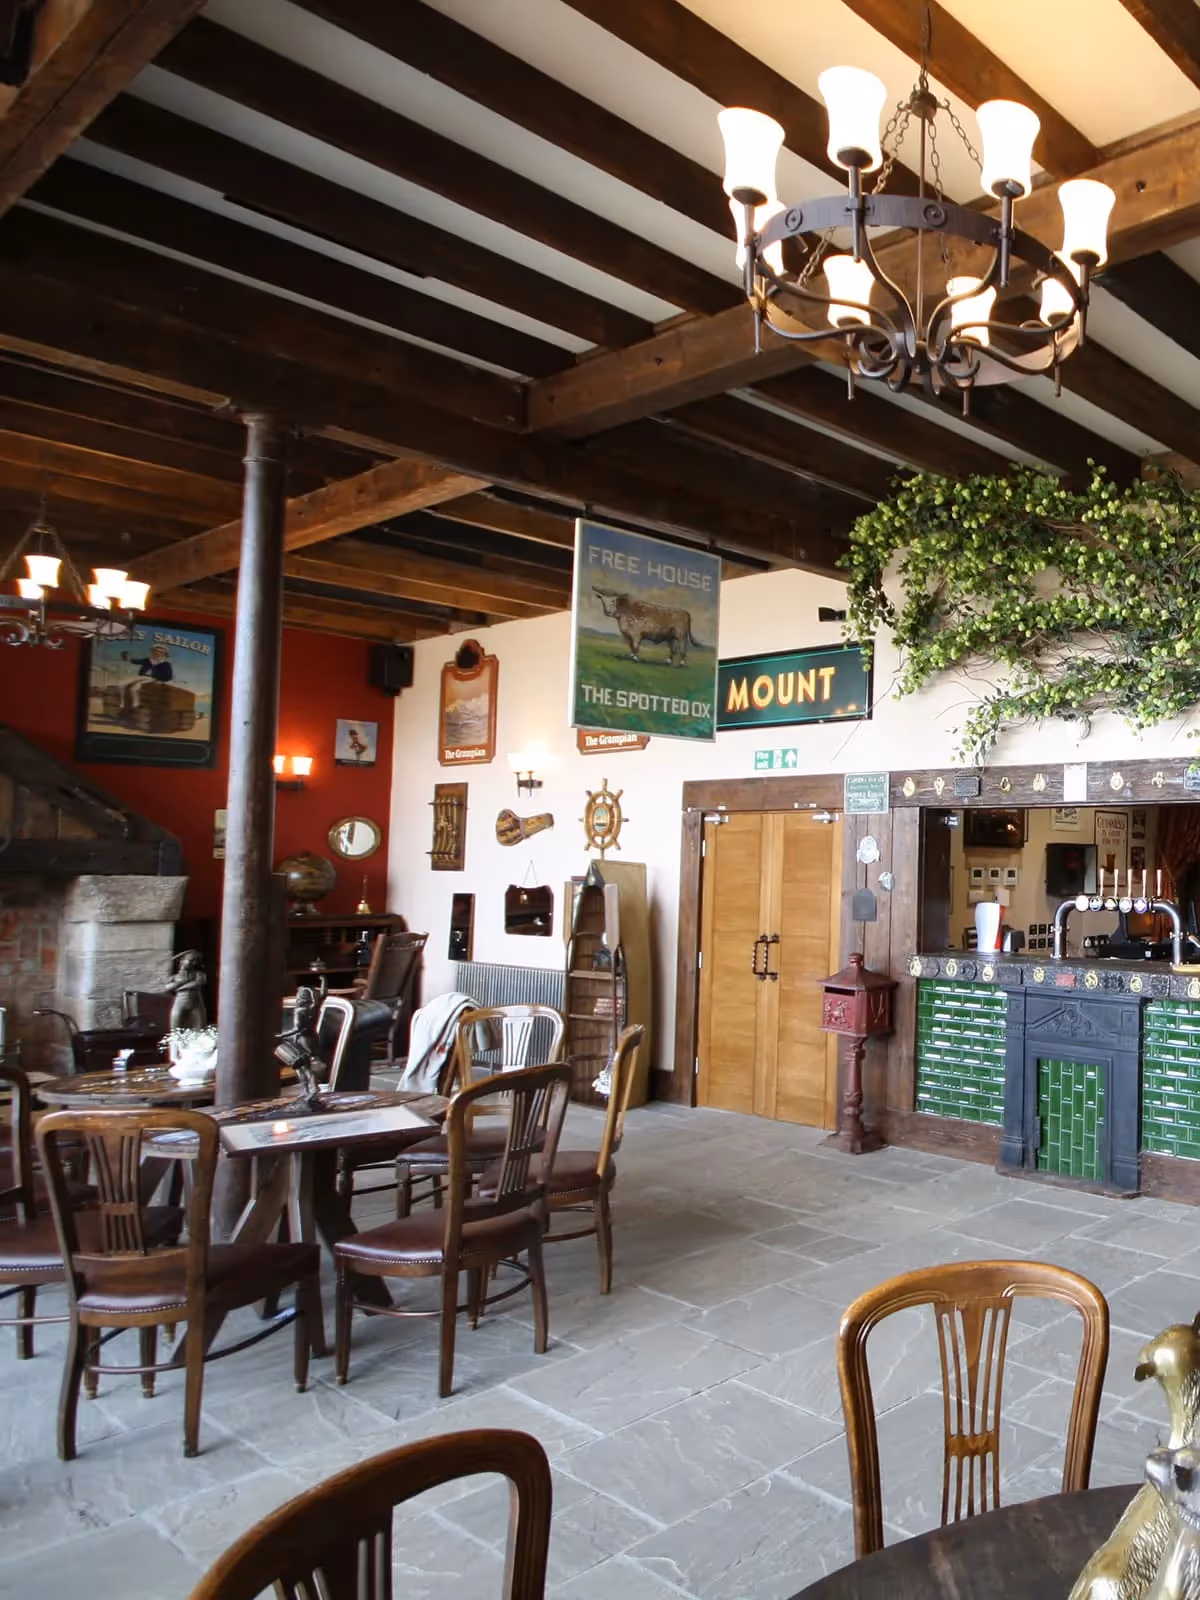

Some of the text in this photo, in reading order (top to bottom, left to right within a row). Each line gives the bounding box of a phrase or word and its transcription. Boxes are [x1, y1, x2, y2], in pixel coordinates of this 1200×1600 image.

[588, 545, 712, 592] FREE HOUSE
[581, 684, 711, 718] THE SPOTTED OX
[726, 666, 836, 713] MOUNT
[445, 749, 486, 759] The Grampian
[585, 735, 637, 746] The Grampian
